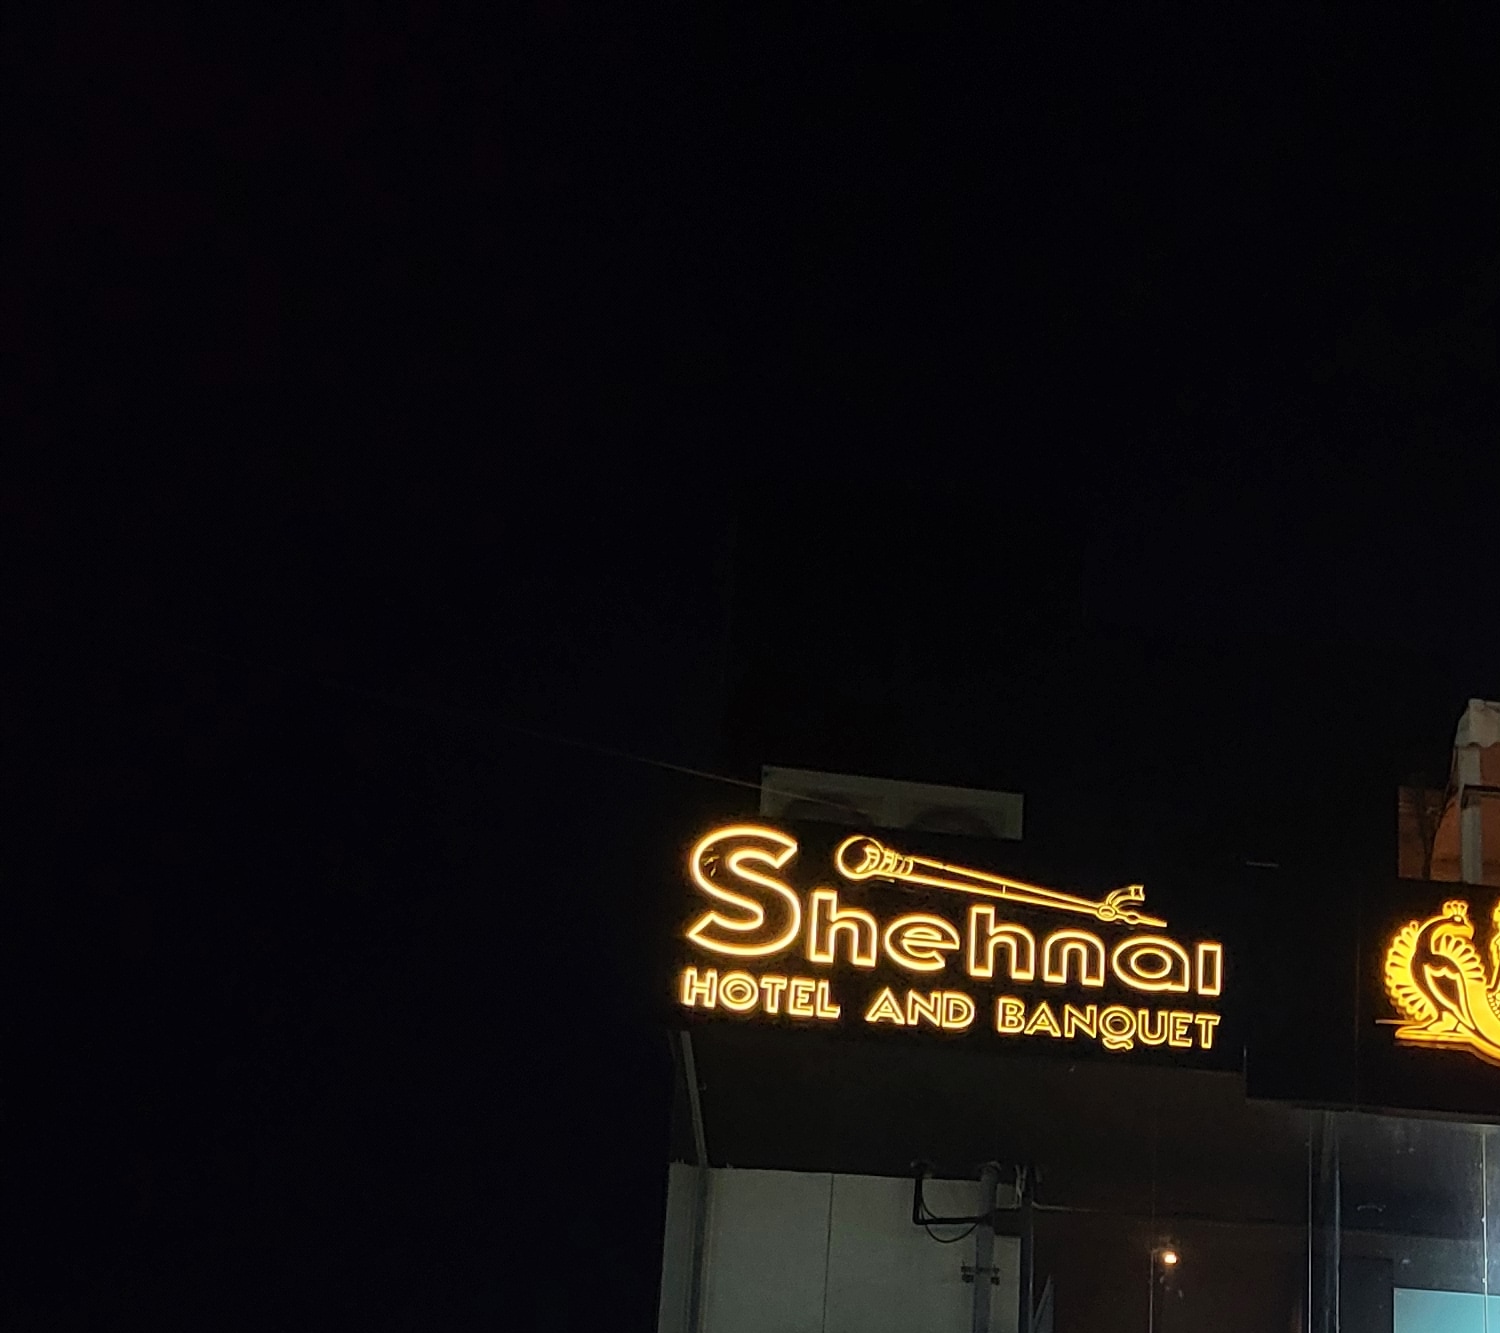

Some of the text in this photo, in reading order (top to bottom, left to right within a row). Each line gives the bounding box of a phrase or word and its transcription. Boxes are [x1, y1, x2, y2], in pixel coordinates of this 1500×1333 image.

[685, 825, 1225, 997] Shehnai
[682, 967, 1221, 1051] HOTEL AND BANQUET
